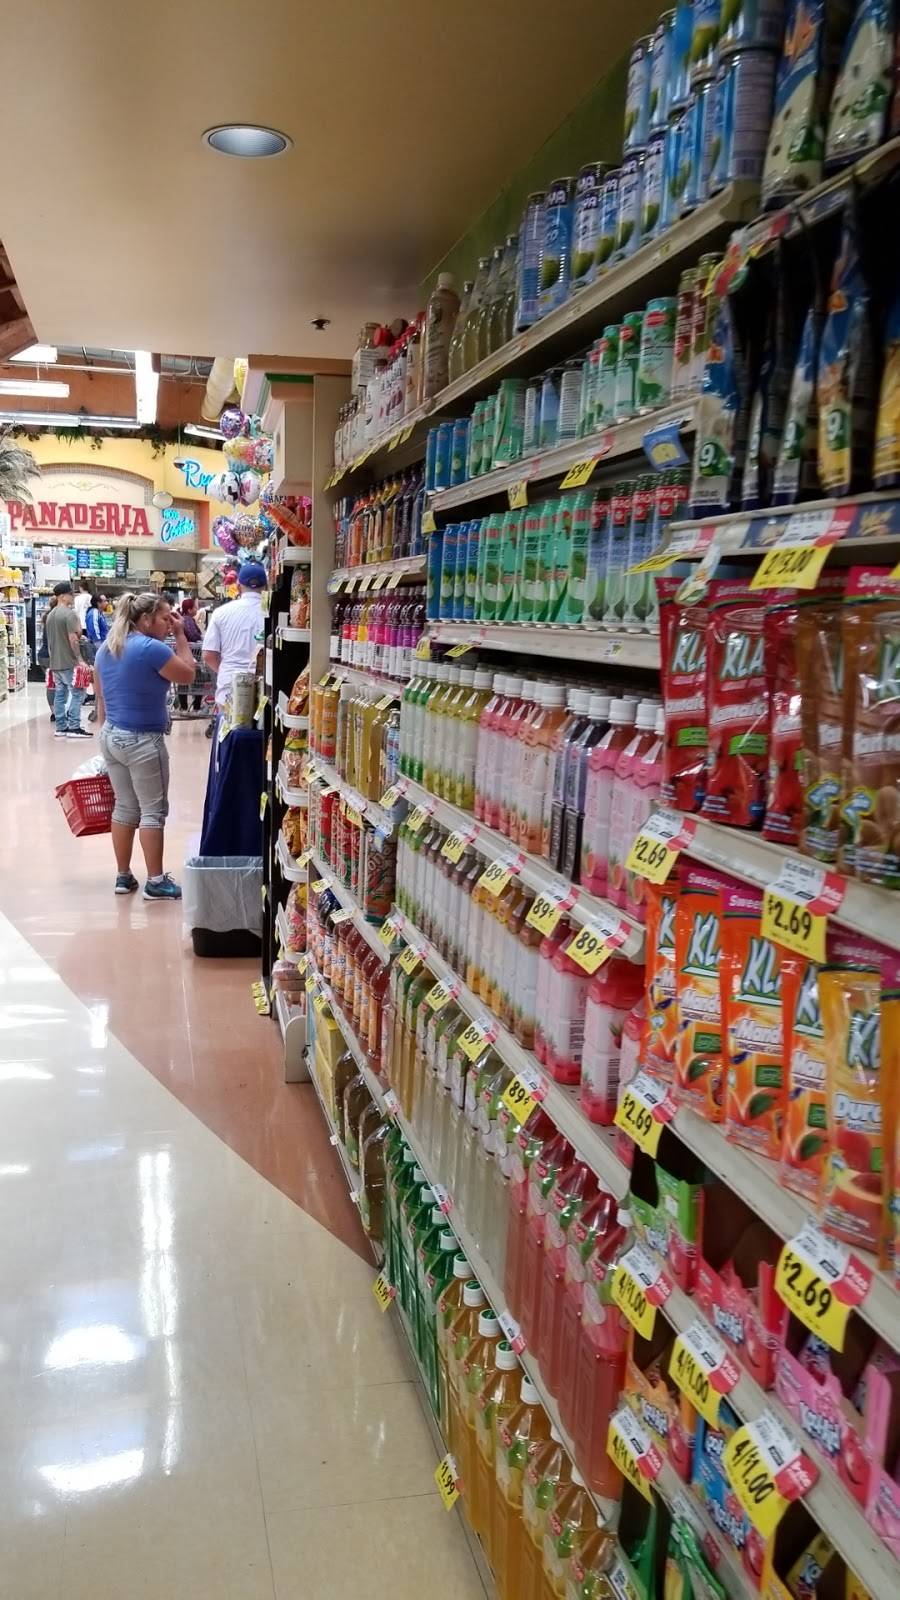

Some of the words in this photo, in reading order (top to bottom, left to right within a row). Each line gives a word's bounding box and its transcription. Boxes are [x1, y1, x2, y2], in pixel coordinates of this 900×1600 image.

[7, 500, 154, 537] PANADERIA
[634, 836, 668, 869] $2.69
[485, 863, 505, 881] 89¢
[533, 898, 556, 919] 89¢
[767, 894, 812, 941] $2.69
[576, 931, 605, 956] 89¢
[431, 983, 448, 1001] 89¢
[464, 1026, 484, 1047] 89¢
[508, 1080, 531, 1106] 89¢
[623, 1094, 653, 1136] $2.69
[619, 1272, 647, 1318] 4/$1.00
[784, 1252, 832, 1318] $2.69
[676, 1348, 709, 1403] 4/$1.00
[441, 1461, 456, 1496] $1.99
[731, 1439, 775, 1504] 4/$1.00
